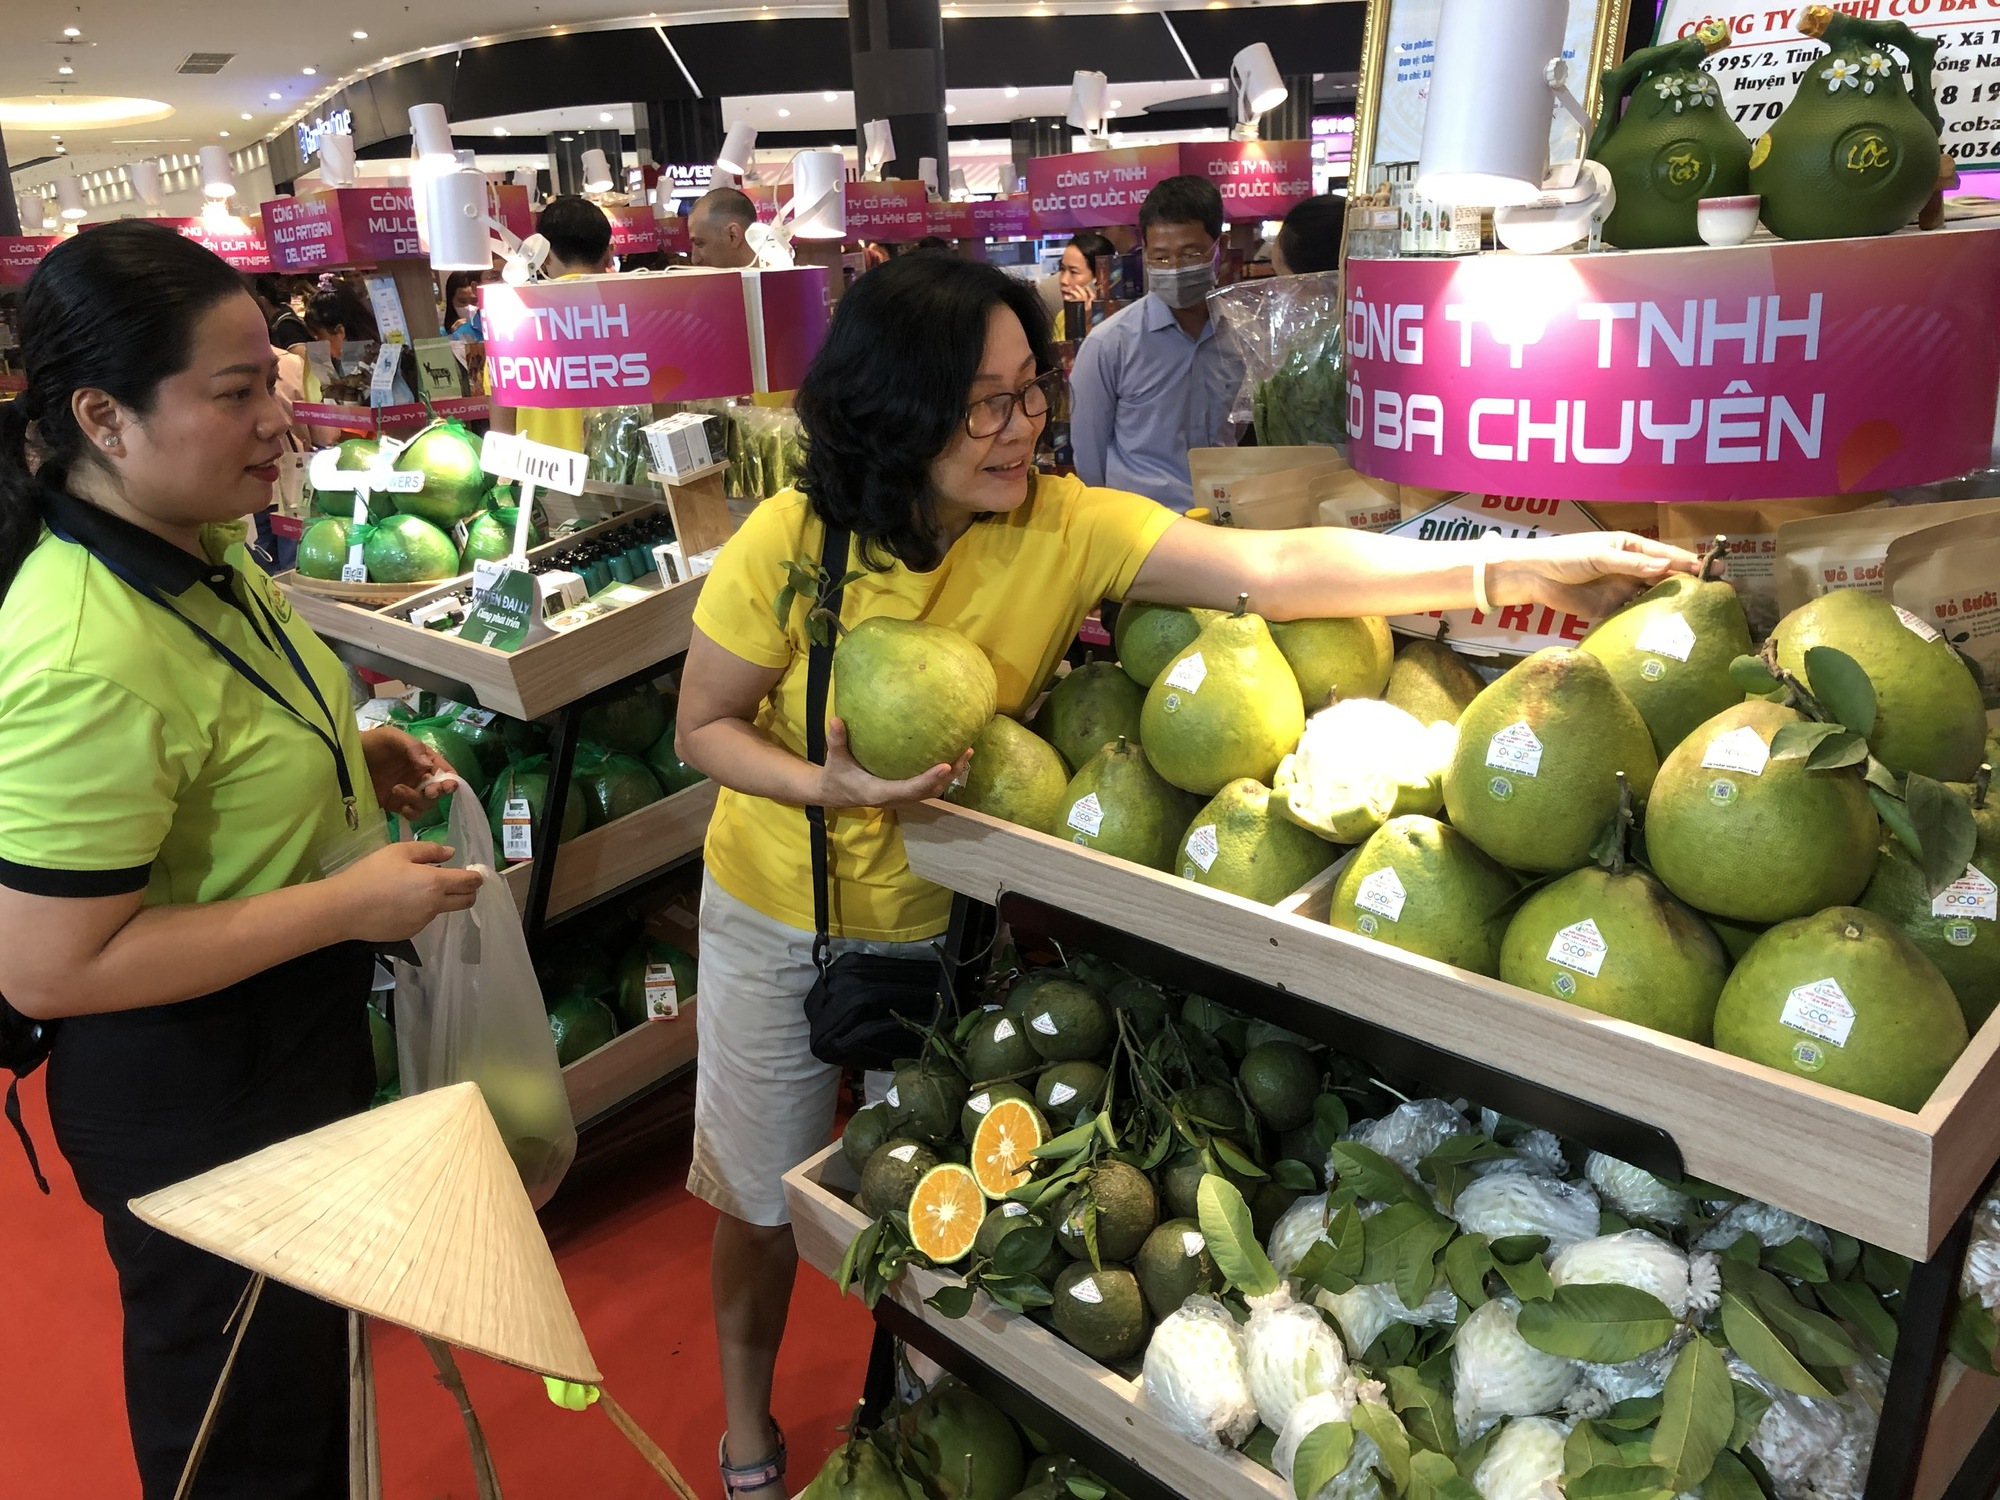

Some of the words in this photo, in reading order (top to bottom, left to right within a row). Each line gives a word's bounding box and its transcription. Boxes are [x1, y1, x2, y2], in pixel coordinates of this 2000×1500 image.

[1677, 13, 1755, 42] CÔG
[1763, 9, 1796, 31] TY
[1701, 58, 1715, 73] ố
[1718, 52, 1779, 72] 995/2,
[1959, 31, 1984, 46] Xã
[1733, 77, 1786, 97] Huyện
[1792, 71, 1806, 85] V
[1734, 101, 1784, 123] 770
[1208, 158, 1240, 176] CÔNG
[1241, 160, 1257, 175] TY
[1259, 160, 1288, 174] TNHH
[1057, 170, 1090, 188] CÔNG
[1093, 170, 1110, 184] TY
[1113, 166, 1147, 182] TNHH
[848, 200, 861, 210] TY
[1129, 189, 1150, 205] NG
[273, 203, 294, 224] CÔNG
[294, 203, 305, 218] TY
[307, 200, 327, 217] TNHH
[846, 213, 870, 228] HIỆP
[907, 212, 922, 223] GIA
[273, 230, 295, 244] MULO
[394, 238, 418, 255] DE
[9, 244, 35, 253] CÔNG
[37, 244, 50, 253] TY
[302, 243, 328, 262] CAFFE
[527, 303, 630, 342] TNHH
[1346, 286, 1424, 366] CÔNG
[1444, 302, 1550, 370] TY
[1577, 292, 1824, 369] TNHH
[499, 352, 651, 390] POWERS
[376, 414, 401, 424] CÔNG
[403, 412, 416, 420] TY
[442, 406, 466, 416] MULO
[1373, 388, 1445, 456] BA
[1468, 378, 1827, 465] CHUYÊN
[1349, 512, 1368, 527] Vỏ
[1370, 507, 1401, 523] Bưởi
[1824, 565, 1848, 583] Vỏ
[1935, 598, 1958, 618] Vỏ
[1962, 591, 1998, 613] Bưởi
[1946, 894, 1985, 905] OCOP
[1562, 942, 1593, 958] OCOP
